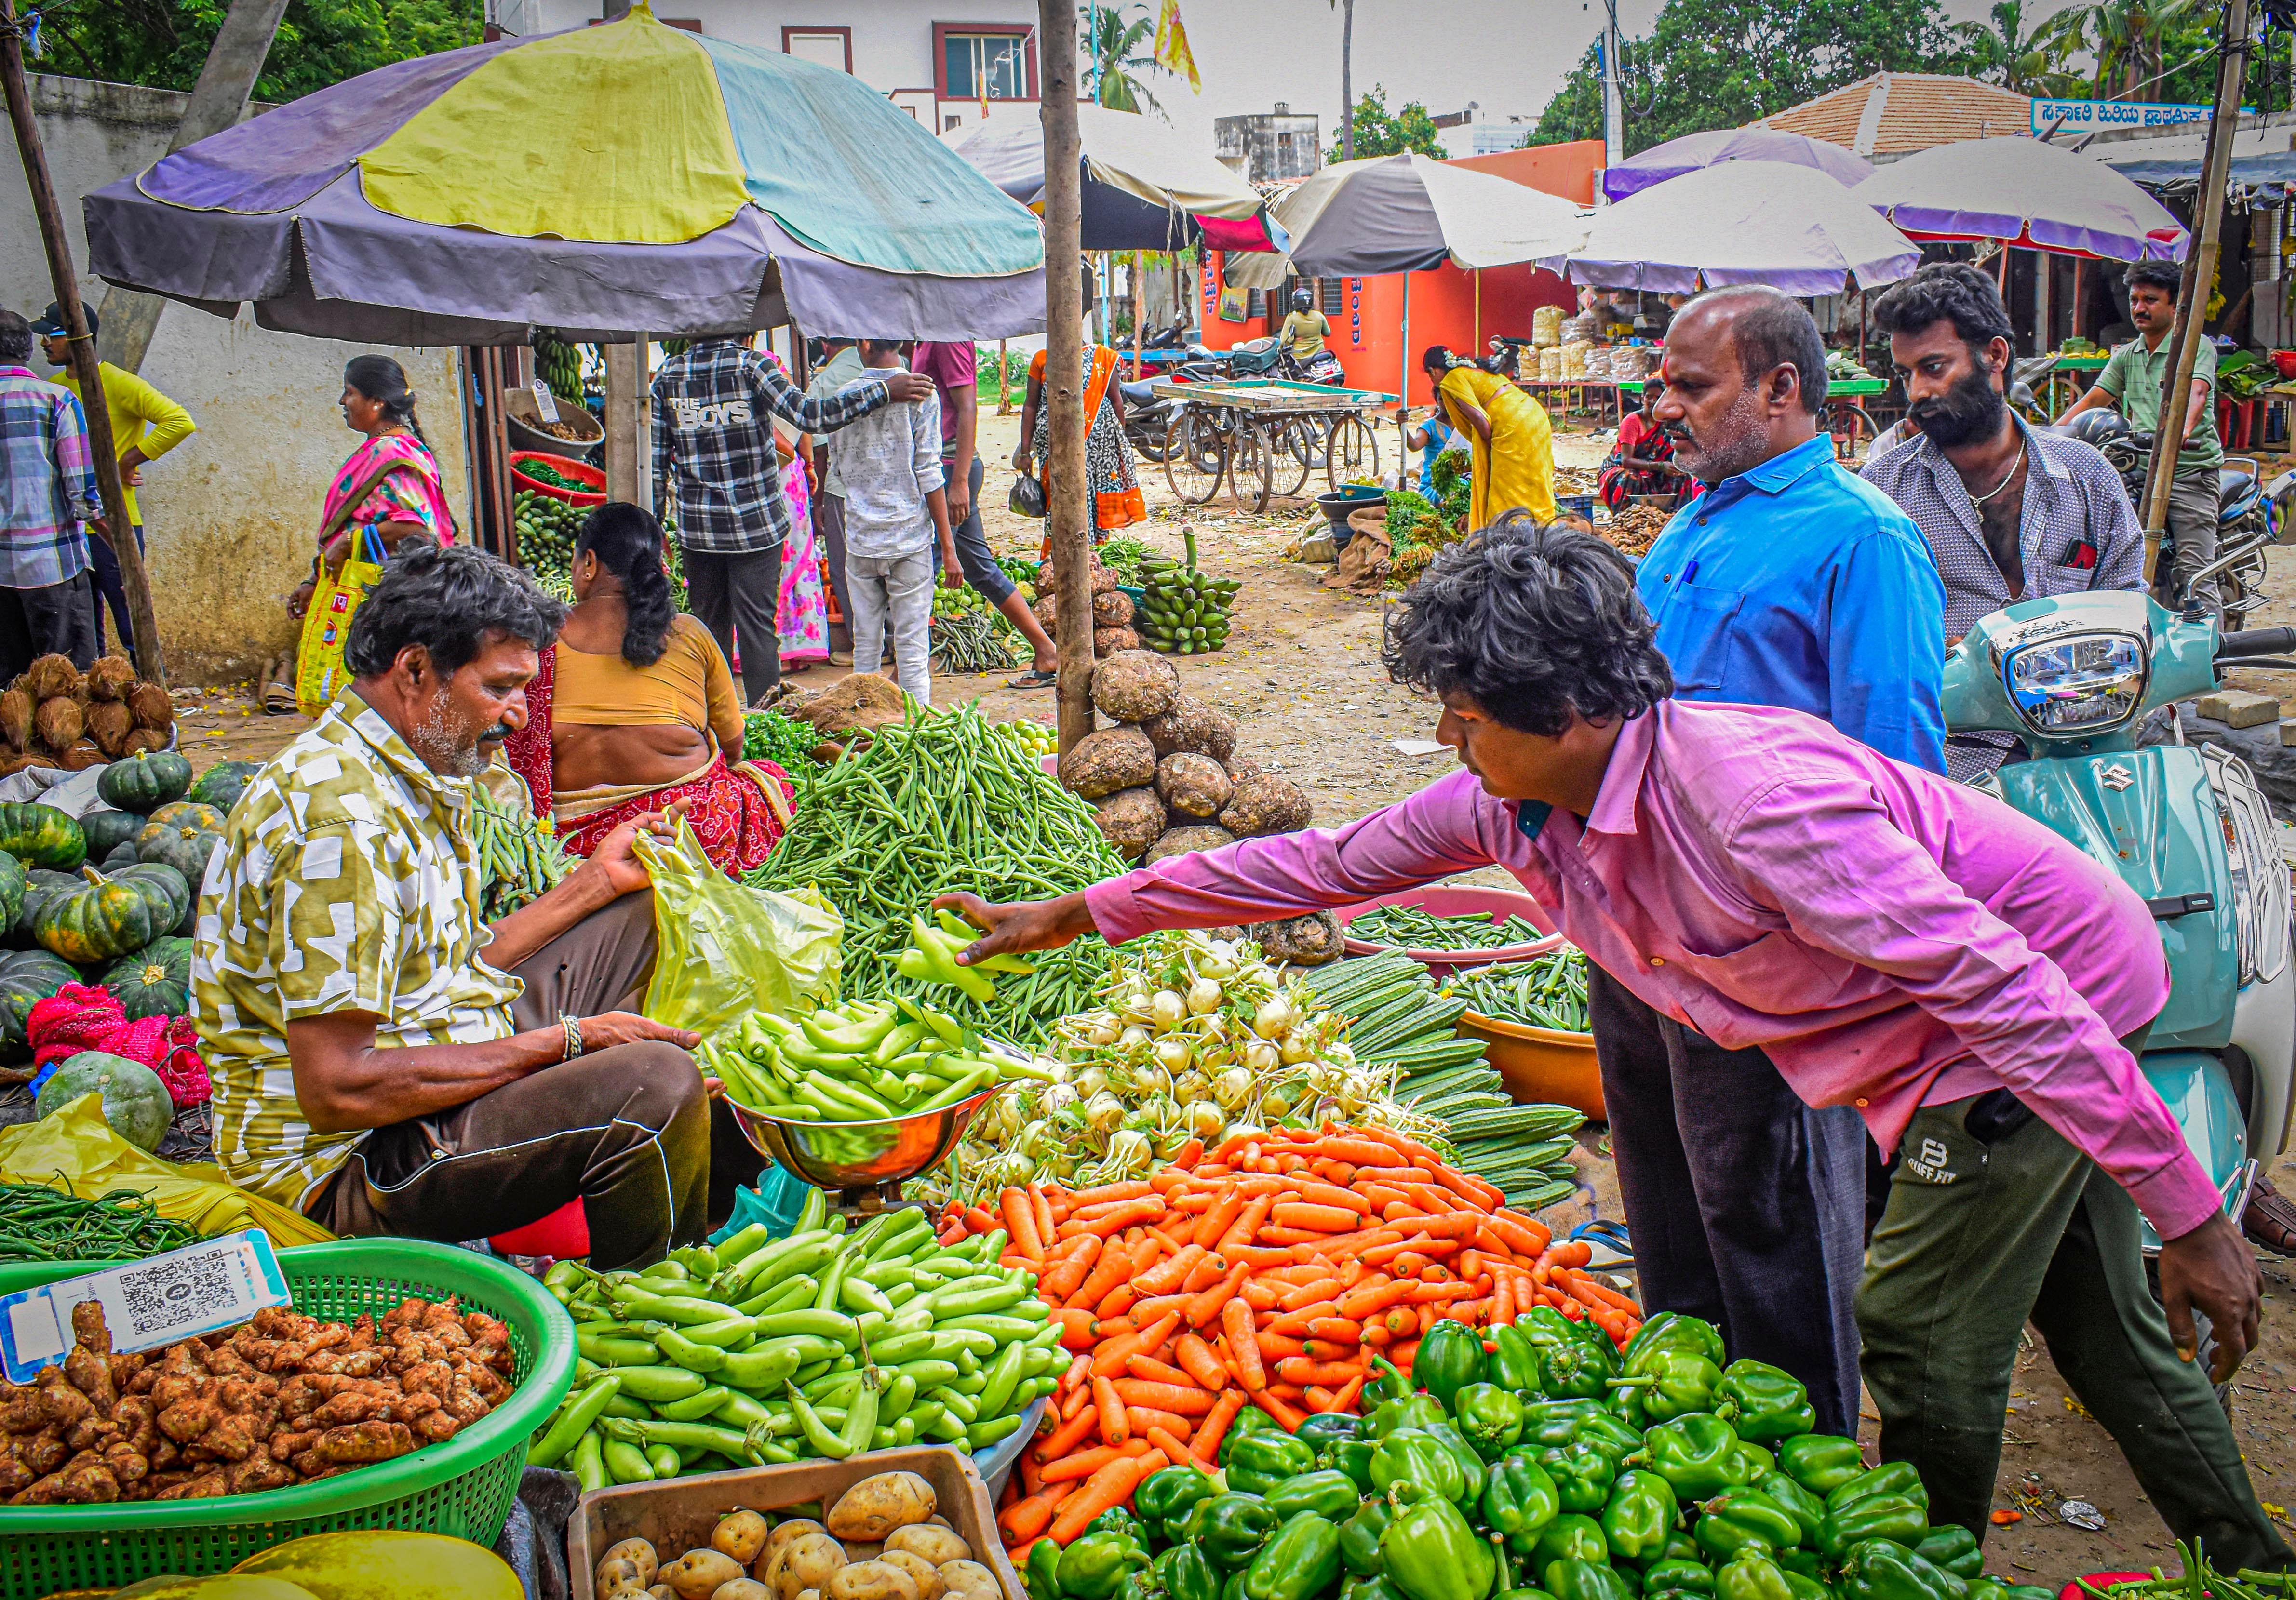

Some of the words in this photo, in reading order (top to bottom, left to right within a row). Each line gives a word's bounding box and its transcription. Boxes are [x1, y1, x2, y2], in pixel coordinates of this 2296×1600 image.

[2098, 105, 2139, 123] ಹಿರಿಯ
[669, 398, 700, 410] THE
[676, 400, 752, 430] BOYS
